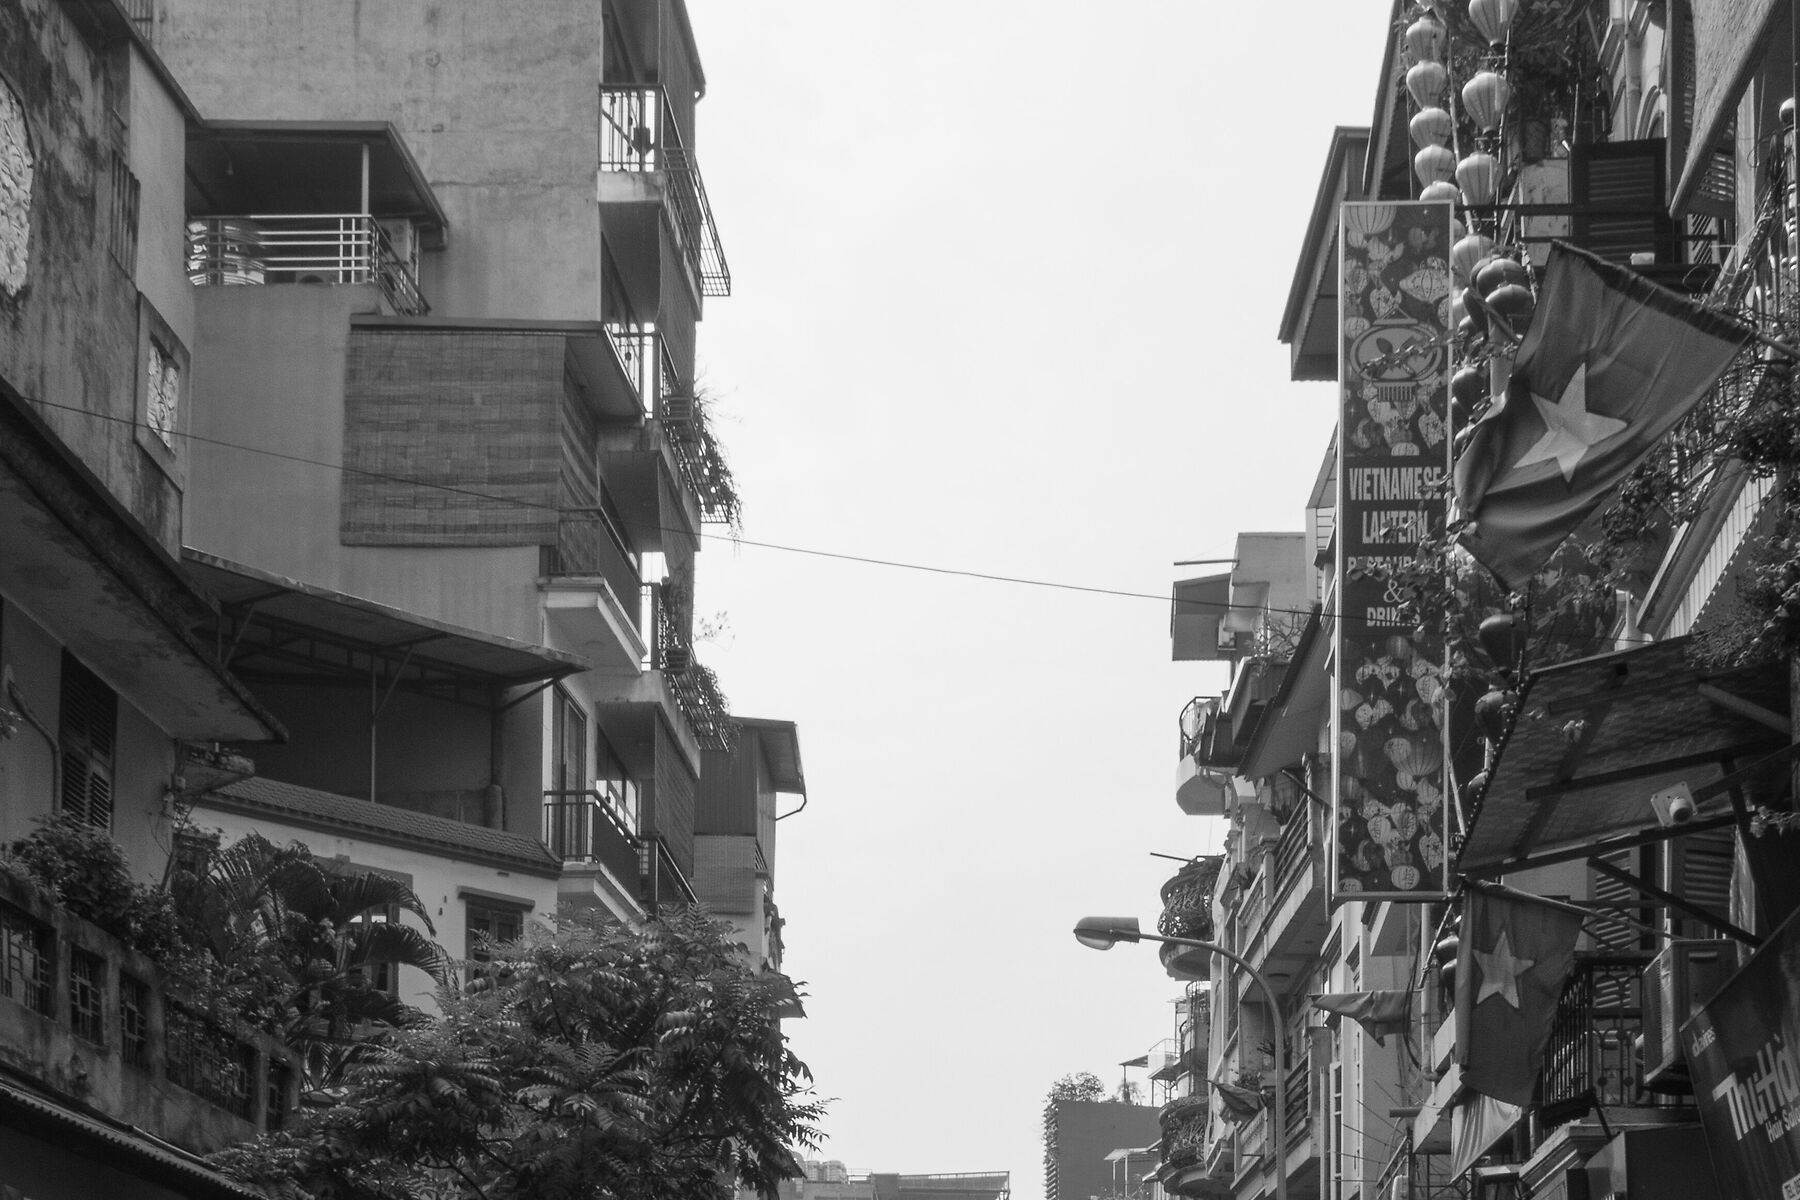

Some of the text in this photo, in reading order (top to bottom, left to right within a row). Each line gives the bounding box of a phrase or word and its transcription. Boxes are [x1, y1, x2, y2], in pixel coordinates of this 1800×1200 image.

[1349, 467, 1441, 501] VIETNAMESE
[1362, 510, 1428, 544] LANTERN
[1383, 580, 1404, 603] &
[1765, 1115, 1784, 1143] Hair
